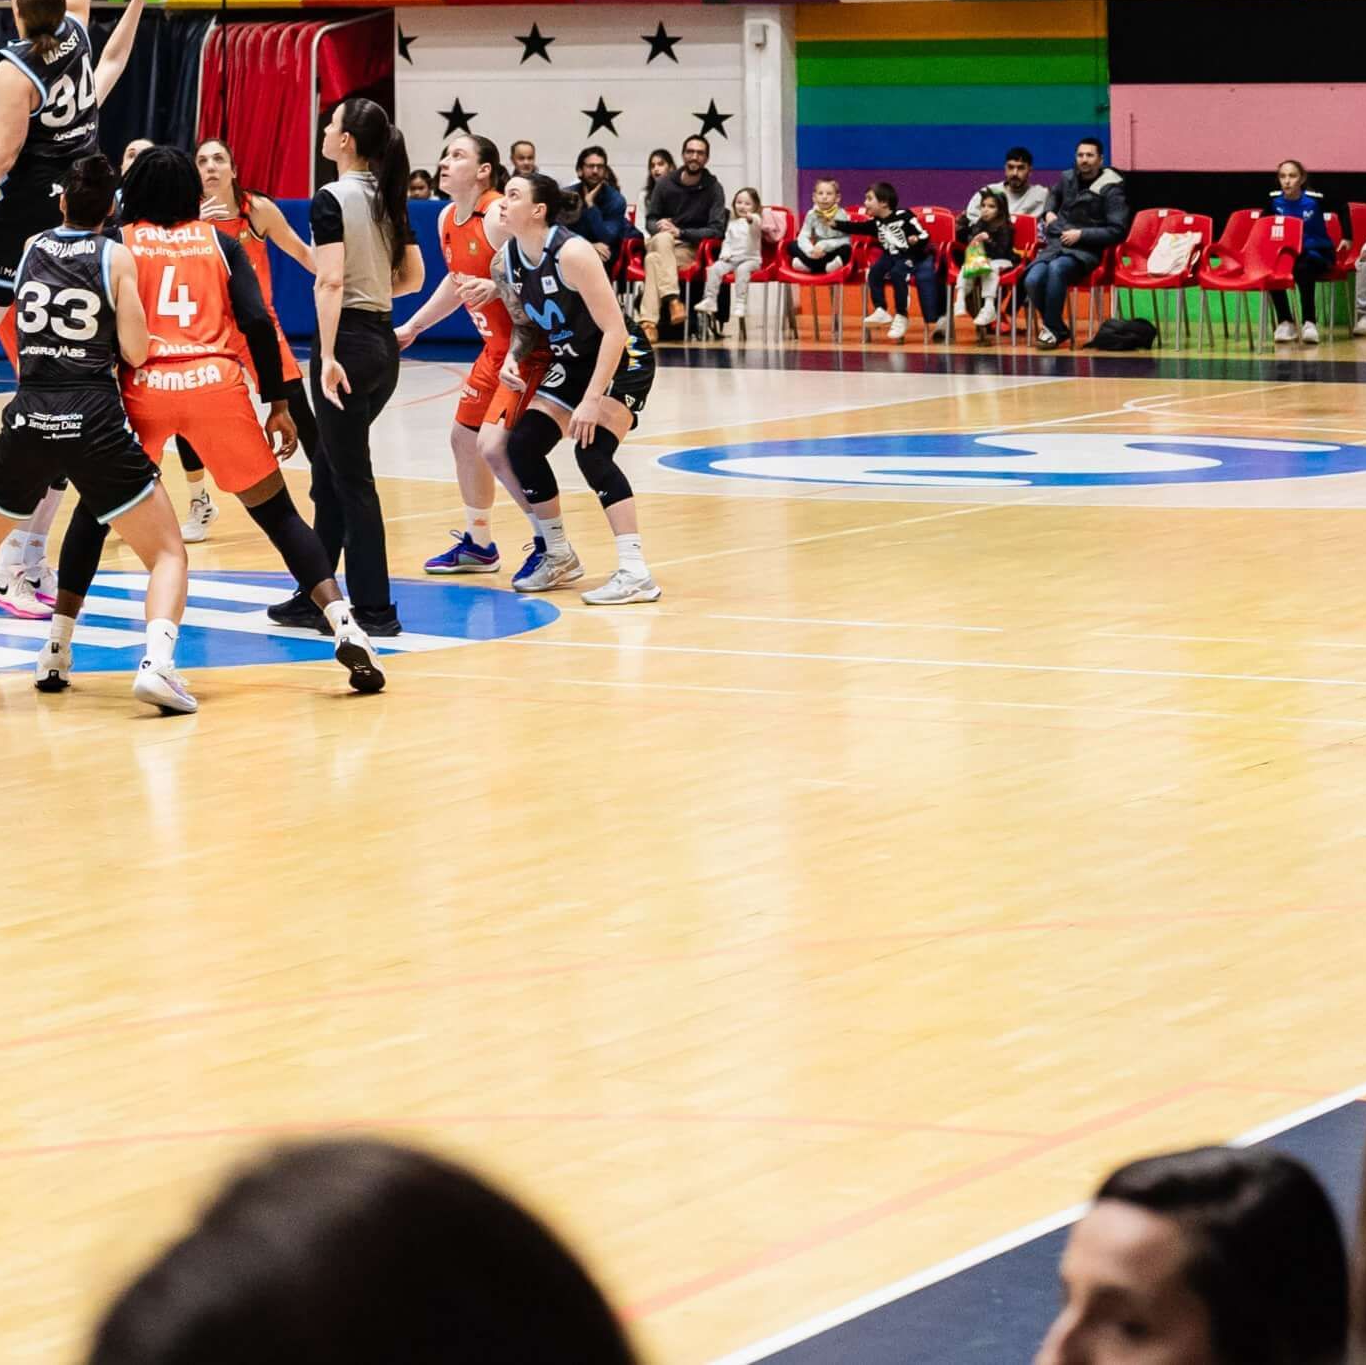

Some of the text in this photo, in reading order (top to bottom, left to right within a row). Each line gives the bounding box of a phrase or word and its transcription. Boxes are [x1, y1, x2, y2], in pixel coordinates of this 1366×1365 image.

[40, 52, 96, 128] 34
[16, 280, 102, 341] 33
[156, 265, 198, 328] 4
[133, 364, 223, 392] PAMESA
